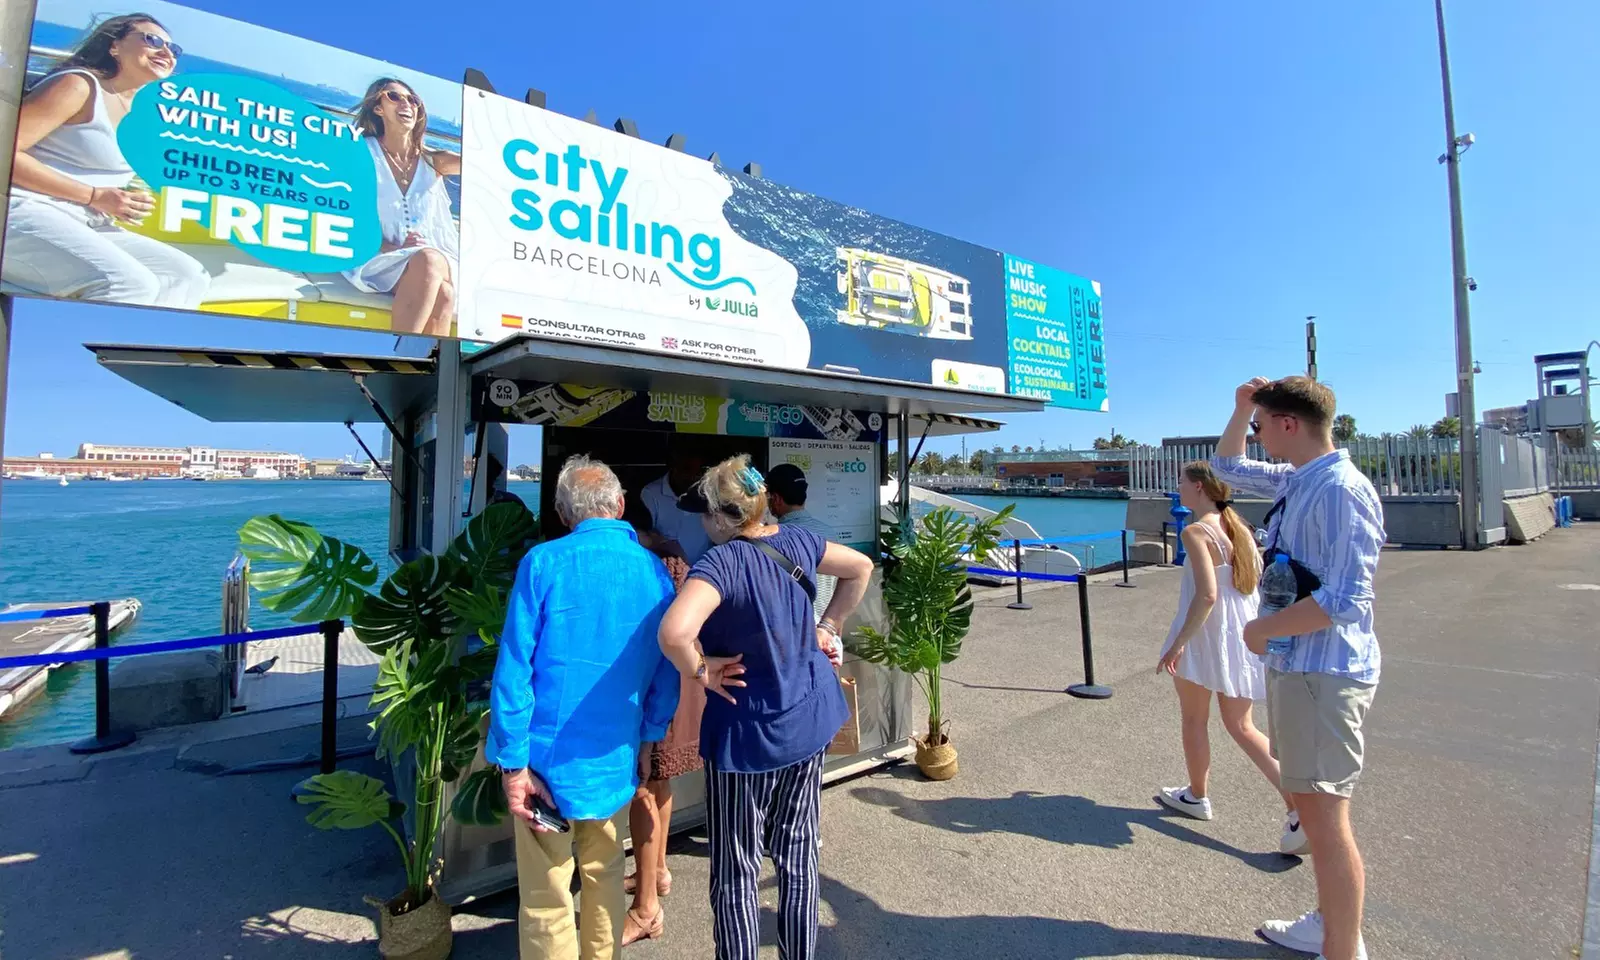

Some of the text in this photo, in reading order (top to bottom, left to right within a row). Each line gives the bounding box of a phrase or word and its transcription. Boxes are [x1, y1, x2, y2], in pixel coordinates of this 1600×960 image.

[160, 82, 364, 142] SAIL THE CITY
[157, 104, 298, 150] WITH US!
[164, 149, 294, 186] CHILDREN
[502, 138, 629, 214] city
[163, 167, 350, 211] UP TO 3 YEARS OLD
[159, 186, 354, 259] FREE
[509, 188, 720, 281] sailing
[513, 241, 662, 287] BARCELONA
[1008, 259, 1035, 279] LIVE
[1010, 278, 1047, 298] MUSIC
[689, 294, 701, 310] by
[1010, 294, 1047, 314] SHOW
[528, 317, 605, 335] CONSULTAR
[606, 328, 646, 340] OTRAS
[1036, 325, 1070, 344] LOCAL
[681, 339, 702, 348] ASK
[703, 342, 723, 351] FOR
[725, 345, 756, 355] OTHER
[1013, 338, 1071, 360] COCKTAILS
[1073, 287, 1086, 400] BUY TICKETS
[1088, 299, 1105, 390] HERE
[1014, 363, 1063, 380] ECOLOGICAL
[496, 385, 512, 393] 90
[1014, 375, 1075, 392] & SUSTAINABLE
[1015, 386, 1052, 401] SAILINGS
[769, 406, 803, 425] ECO
[772, 441, 802, 449] SORTIDES
[844, 461, 867, 473] ECO
